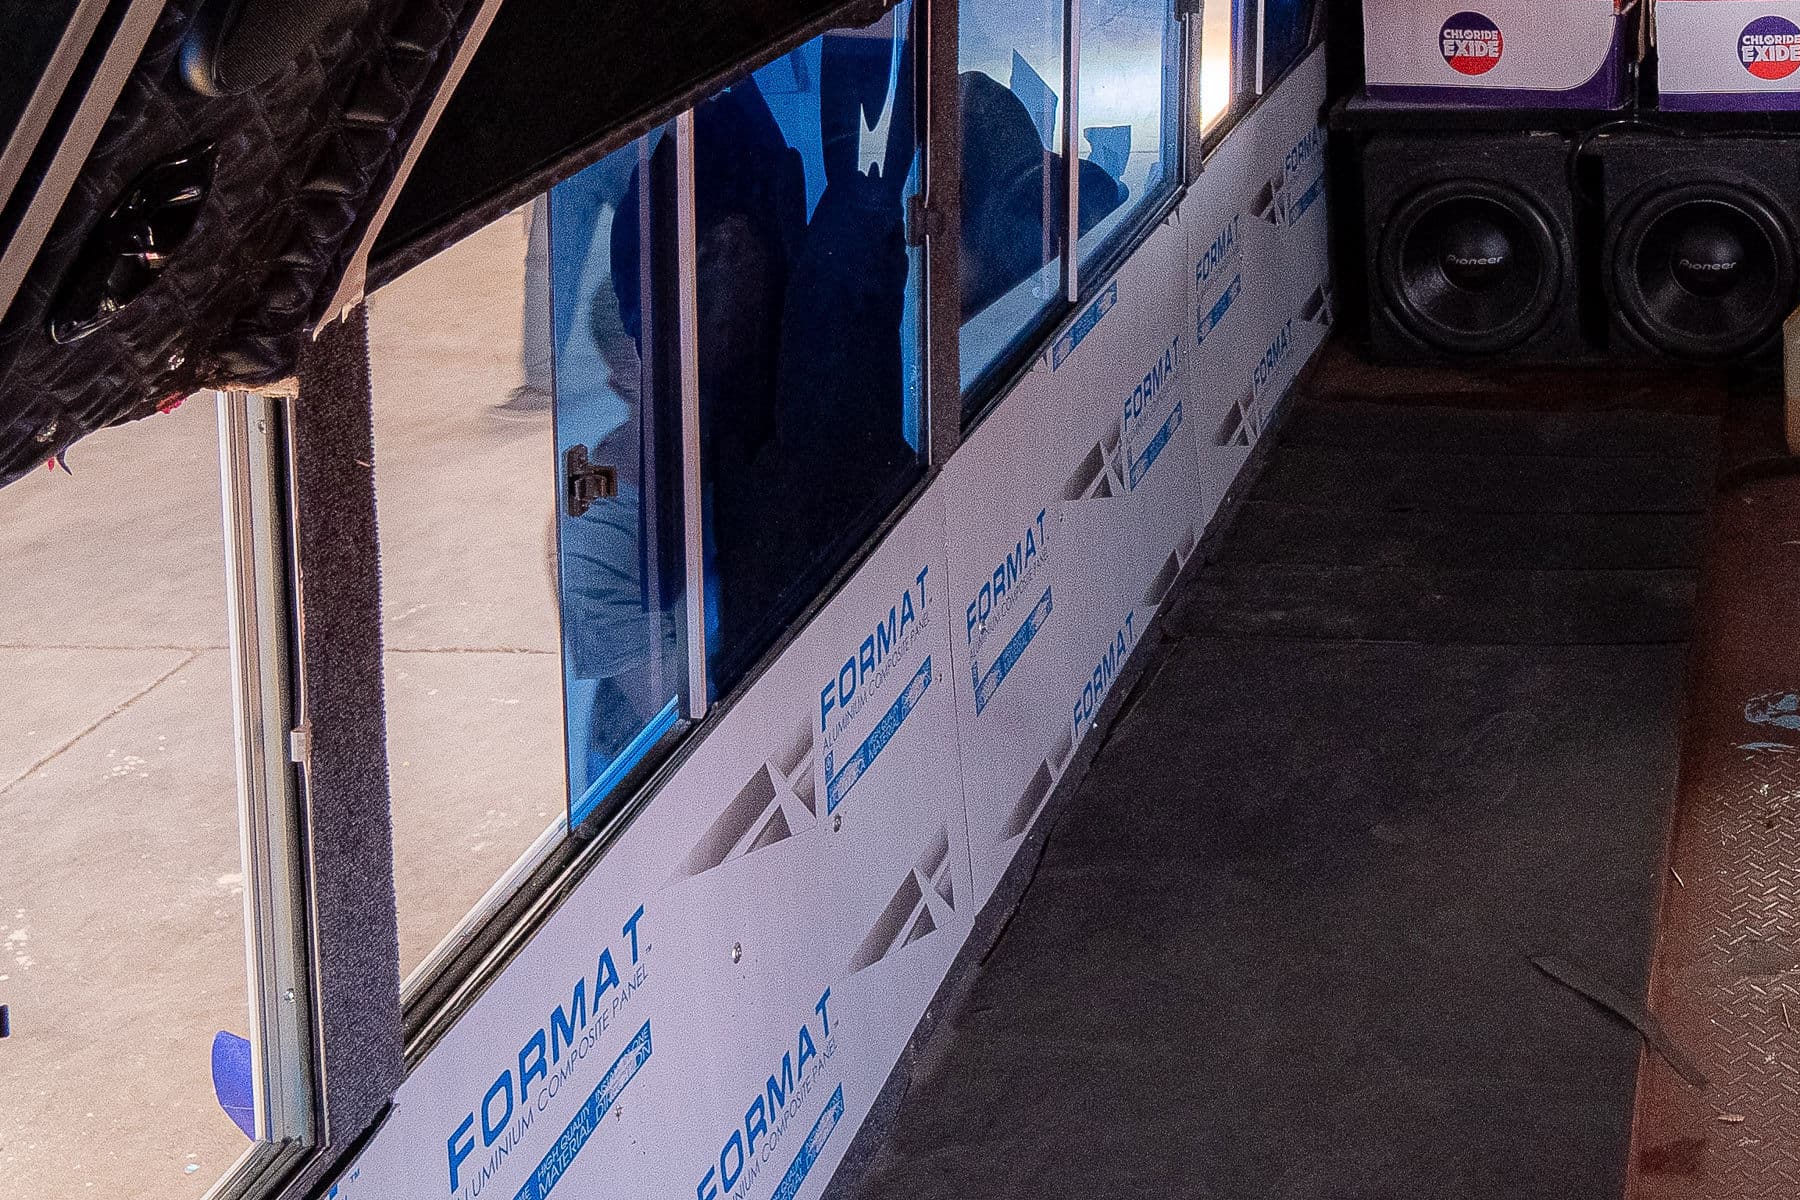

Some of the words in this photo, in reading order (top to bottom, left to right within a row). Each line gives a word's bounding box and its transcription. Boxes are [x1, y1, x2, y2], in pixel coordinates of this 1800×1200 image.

[1443, 29, 1499, 40] CHLORIDE
[1443, 40, 1499, 57] EXIDE
[1196, 213, 1239, 291] FORMAT
[1448, 254, 1503, 265] Pioneer
[1679, 259, 1737, 271] Pioneer
[1124, 335, 1179, 432] FORMAT
[1253, 317, 1292, 397] FORMAT
[966, 507, 1046, 644] FORMAT
[821, 565, 929, 733] FORMAT
[1073, 609, 1135, 737] FORMAT
[447, 903, 644, 1194] FORMAT
[537, 1008, 610, 1112] COMPOSITE
[612, 963, 649, 1018] PANEL
[696, 986, 831, 1200] FORMAT
[537, 1145, 561, 1182] HIGH
[538, 1119, 593, 1200] MATERIAL
